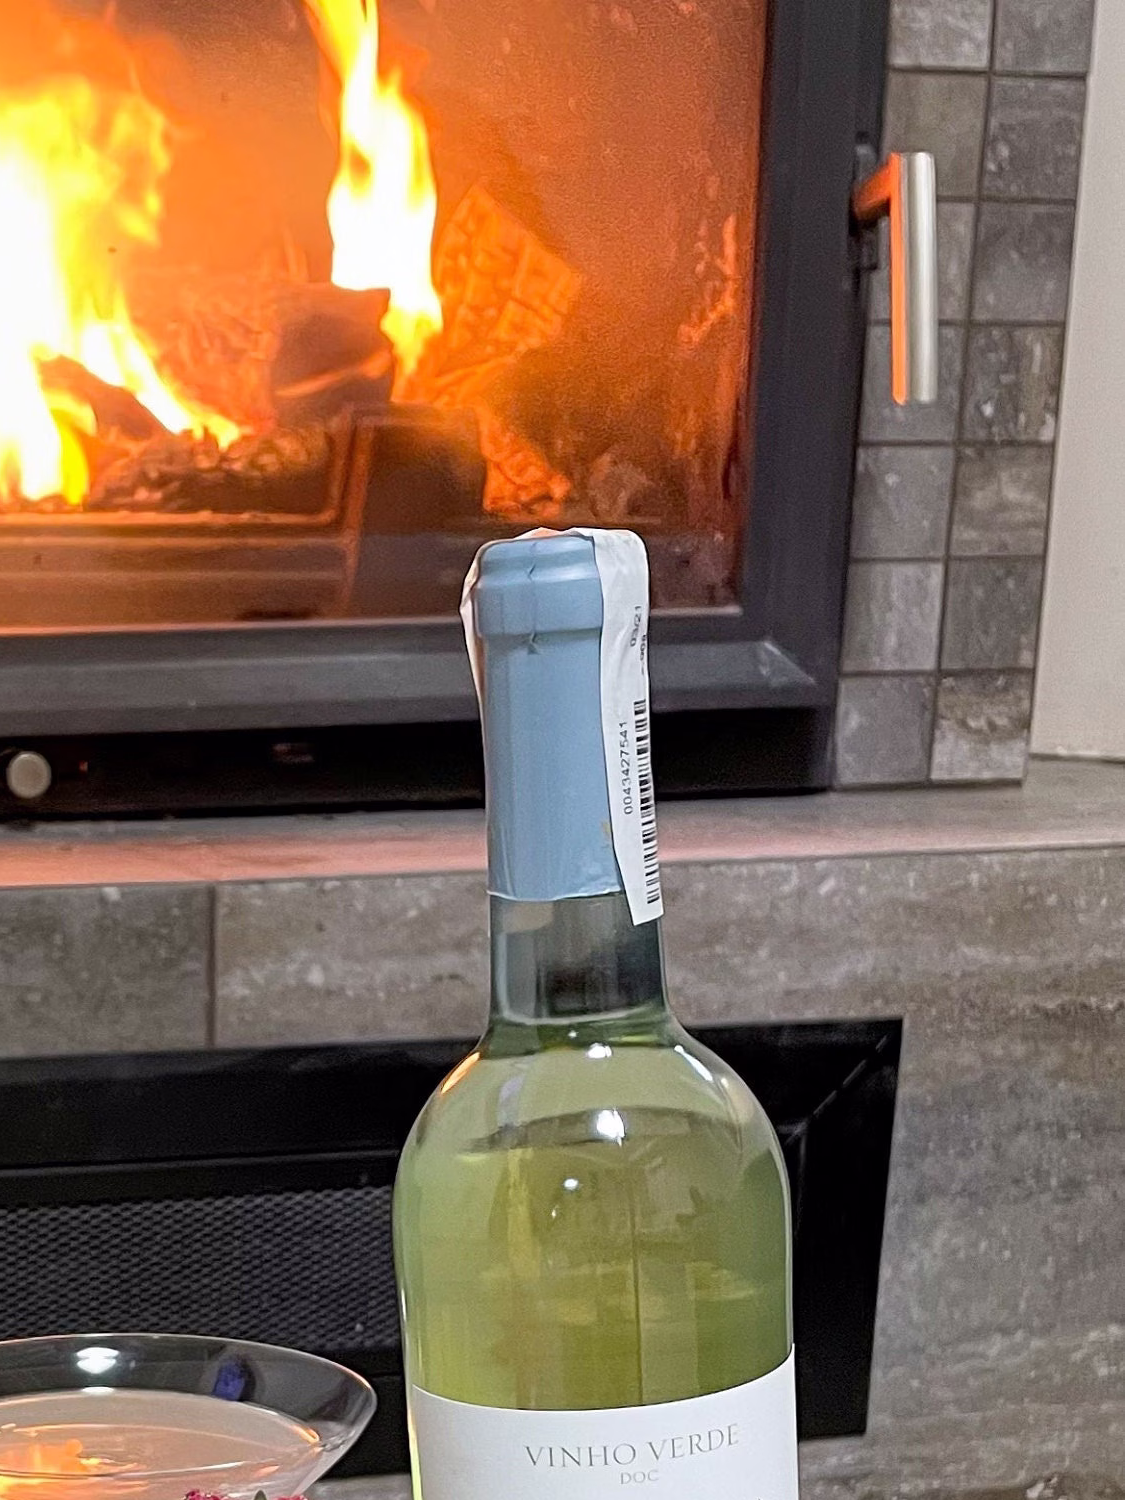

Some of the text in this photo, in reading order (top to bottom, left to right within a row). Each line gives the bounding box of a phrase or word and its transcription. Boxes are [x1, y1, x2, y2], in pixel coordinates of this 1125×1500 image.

[618, 721, 633, 816] 0043427541
[524, 1423, 740, 1468] VINHO VERDE
[619, 1469, 660, 1485] DOC
